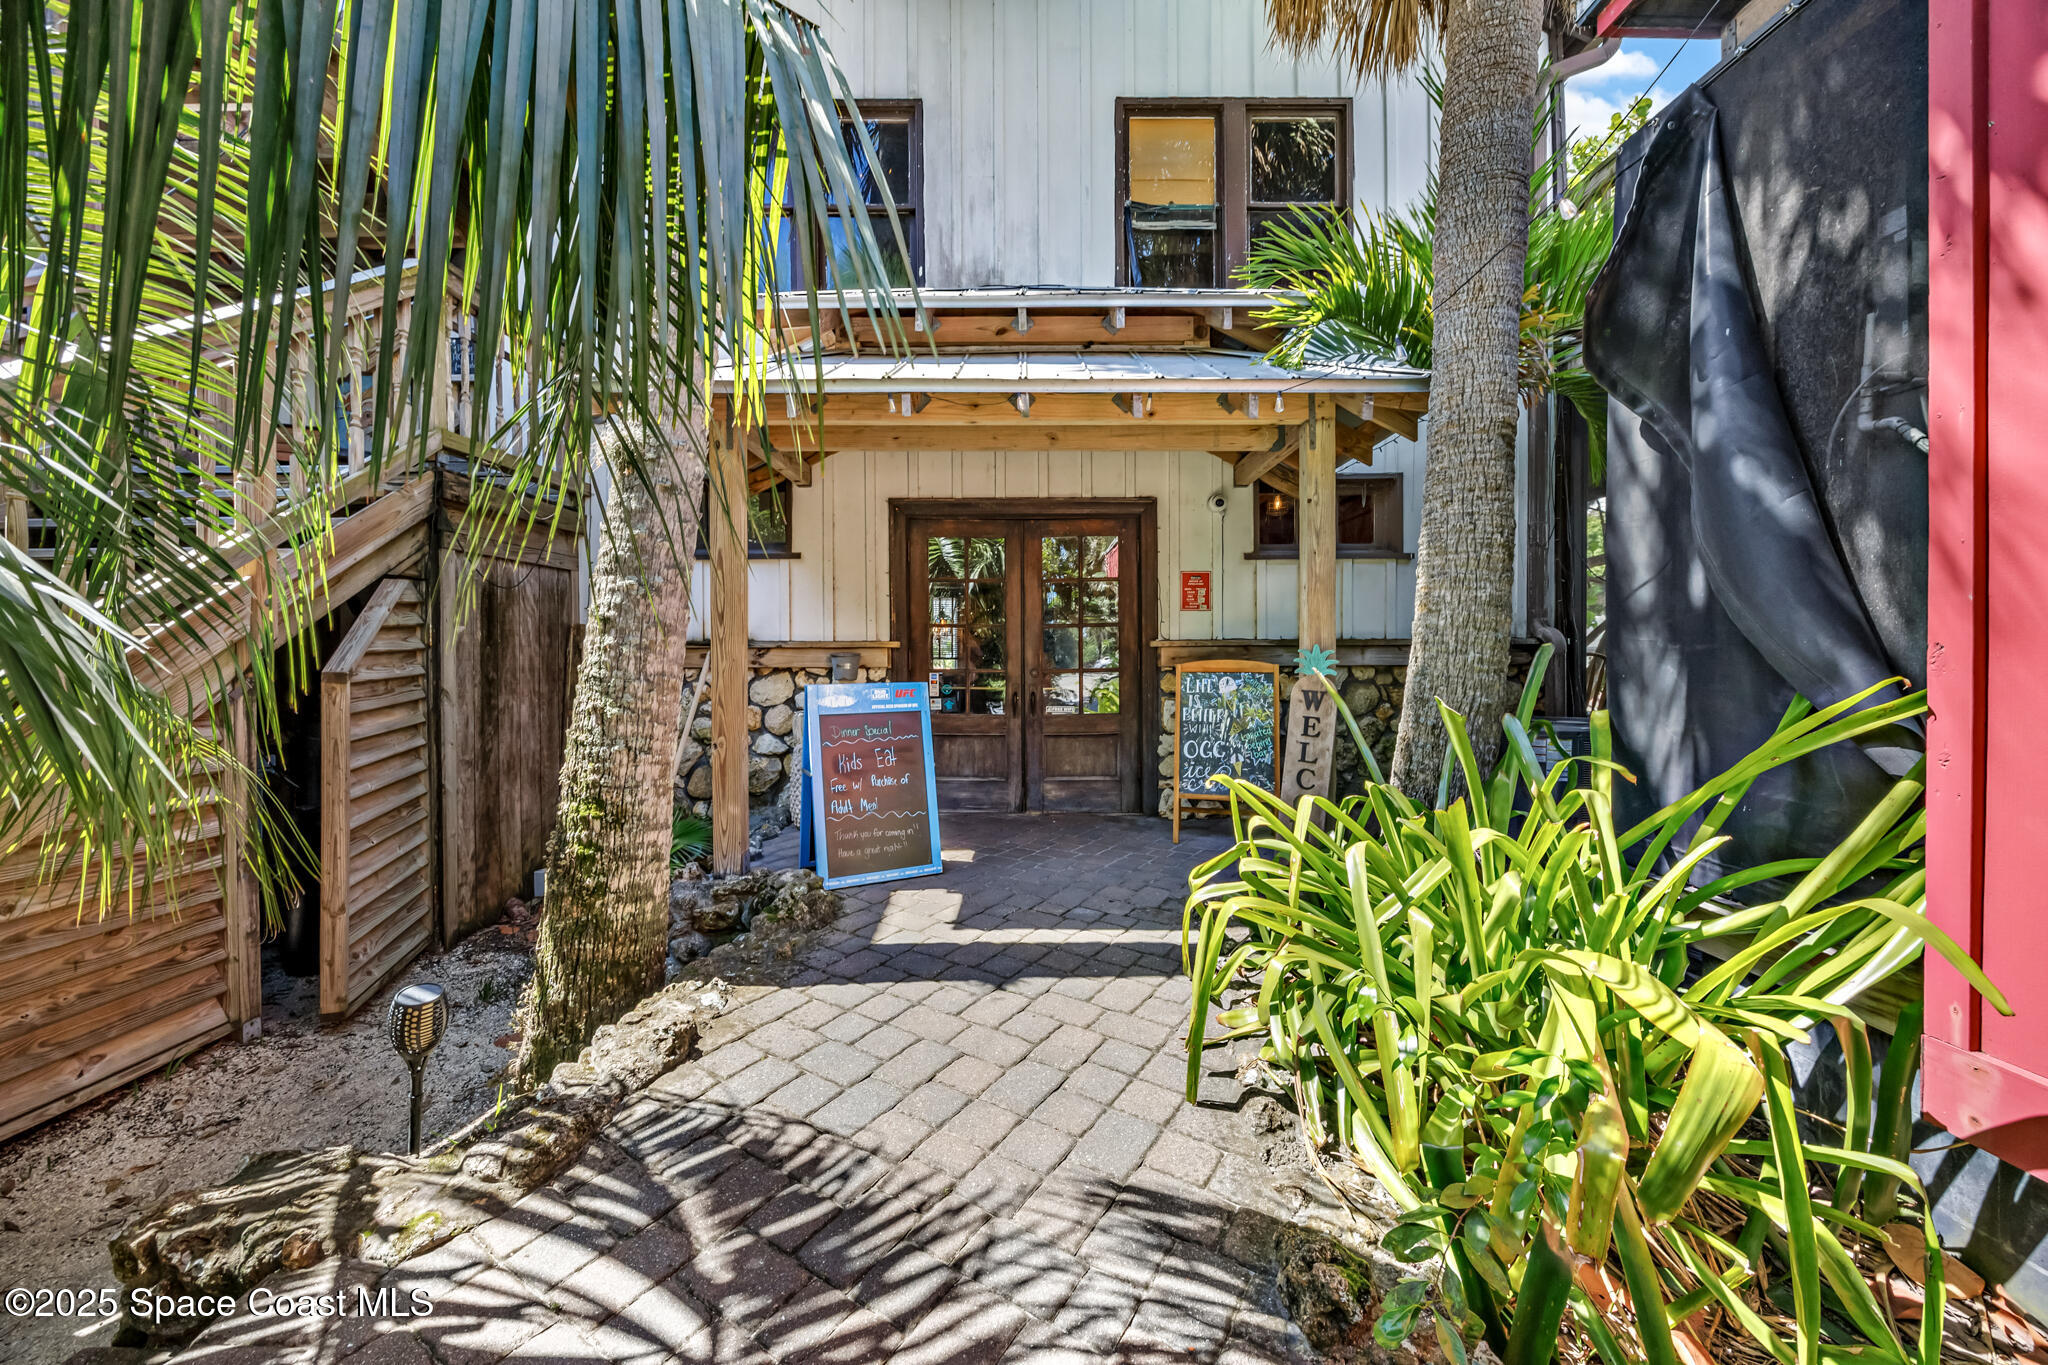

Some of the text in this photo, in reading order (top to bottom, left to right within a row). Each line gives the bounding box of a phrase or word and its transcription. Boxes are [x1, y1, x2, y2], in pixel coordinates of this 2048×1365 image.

[895, 689, 917, 698] UFC
[1186, 677, 1215, 694] LIFE
[1189, 694, 1202, 709] IS
[1182, 707, 1225, 722] BETTER
[830, 720, 892, 740] Dinner Special
[1254, 750, 1267, 758] bar
[1293, 689, 1328, 808] WELC
[838, 746, 896, 773] Kids Eat
[830, 773, 910, 793] Free w/ Purchase of
[831, 797, 878, 814] Adult Meal
[834, 829, 859, 840] Thank
[860, 831, 872, 840] you
[872, 827, 884, 837] for
[885, 829, 906, 840] coming
[838, 849, 855, 858] Have
[864, 844, 881, 860] great
